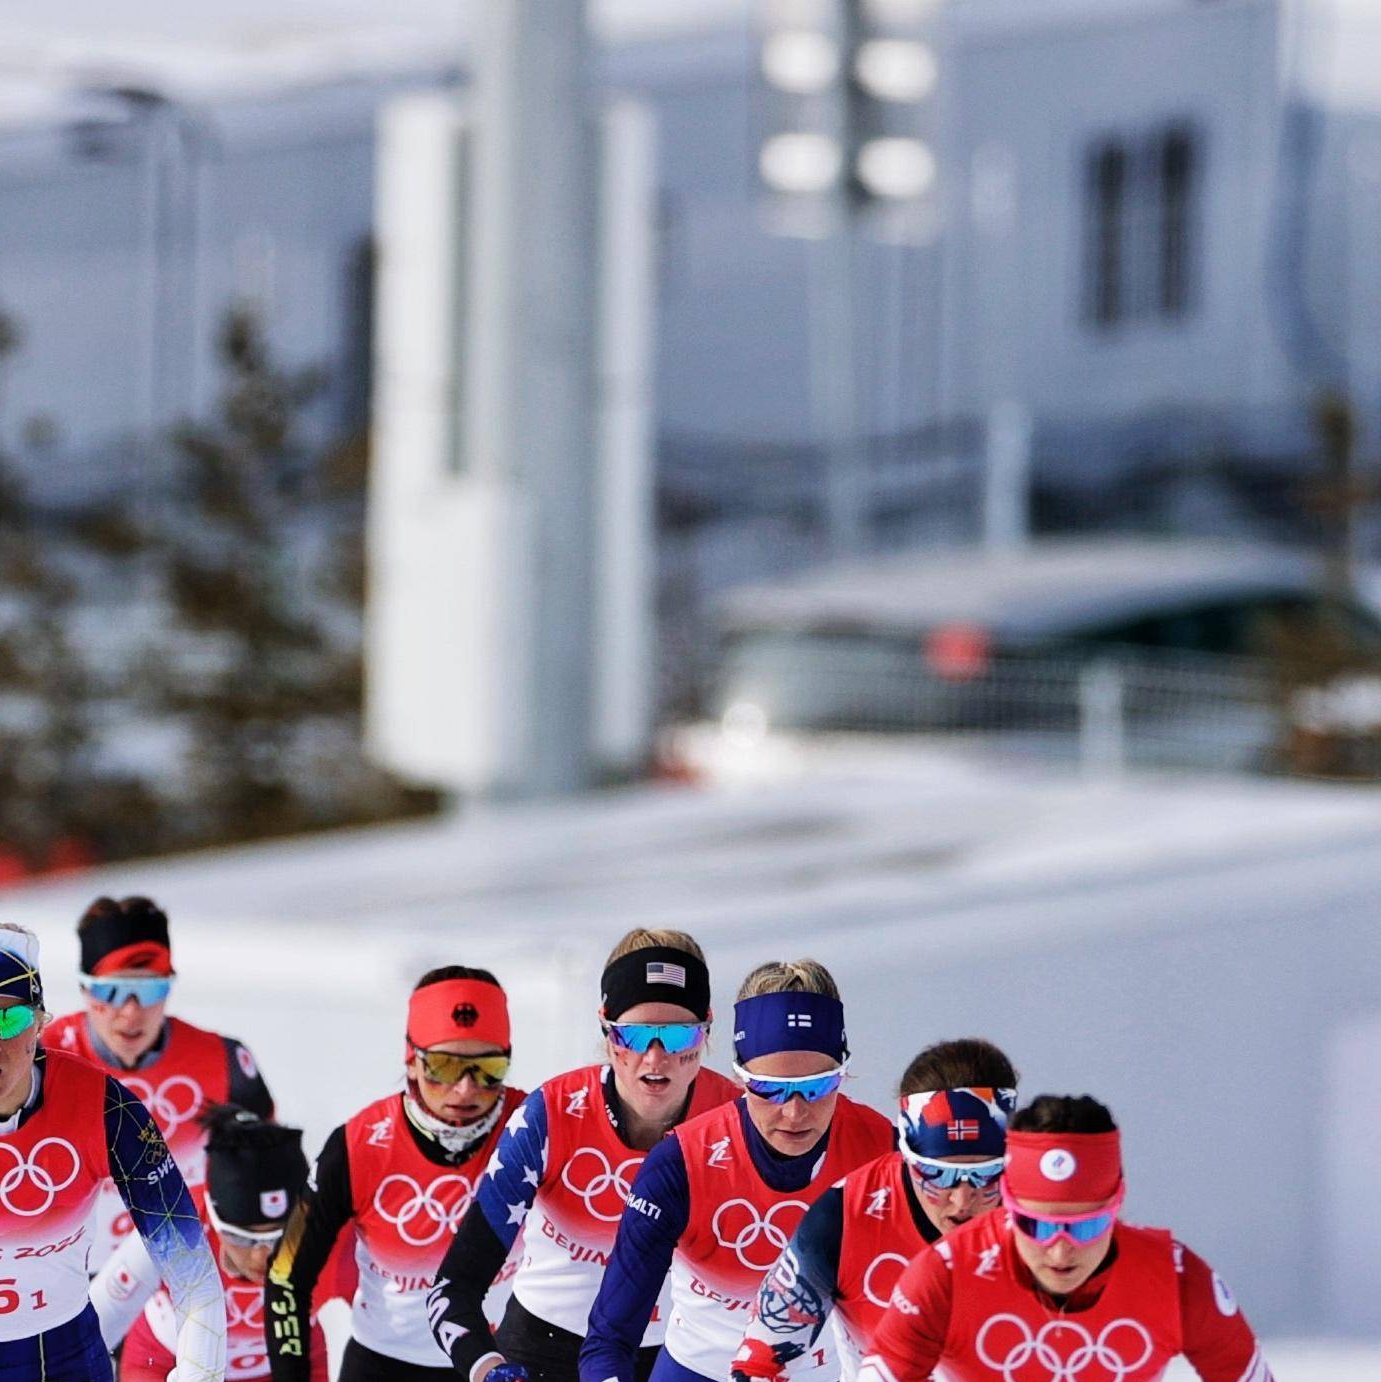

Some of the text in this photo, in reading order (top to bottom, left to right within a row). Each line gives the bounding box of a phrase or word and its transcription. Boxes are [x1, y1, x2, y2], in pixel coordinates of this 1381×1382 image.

[147, 1152, 177, 1185] SWE
[541, 1215, 610, 1267] BEIJIN
[30, 1290, 48, 1311] 1
